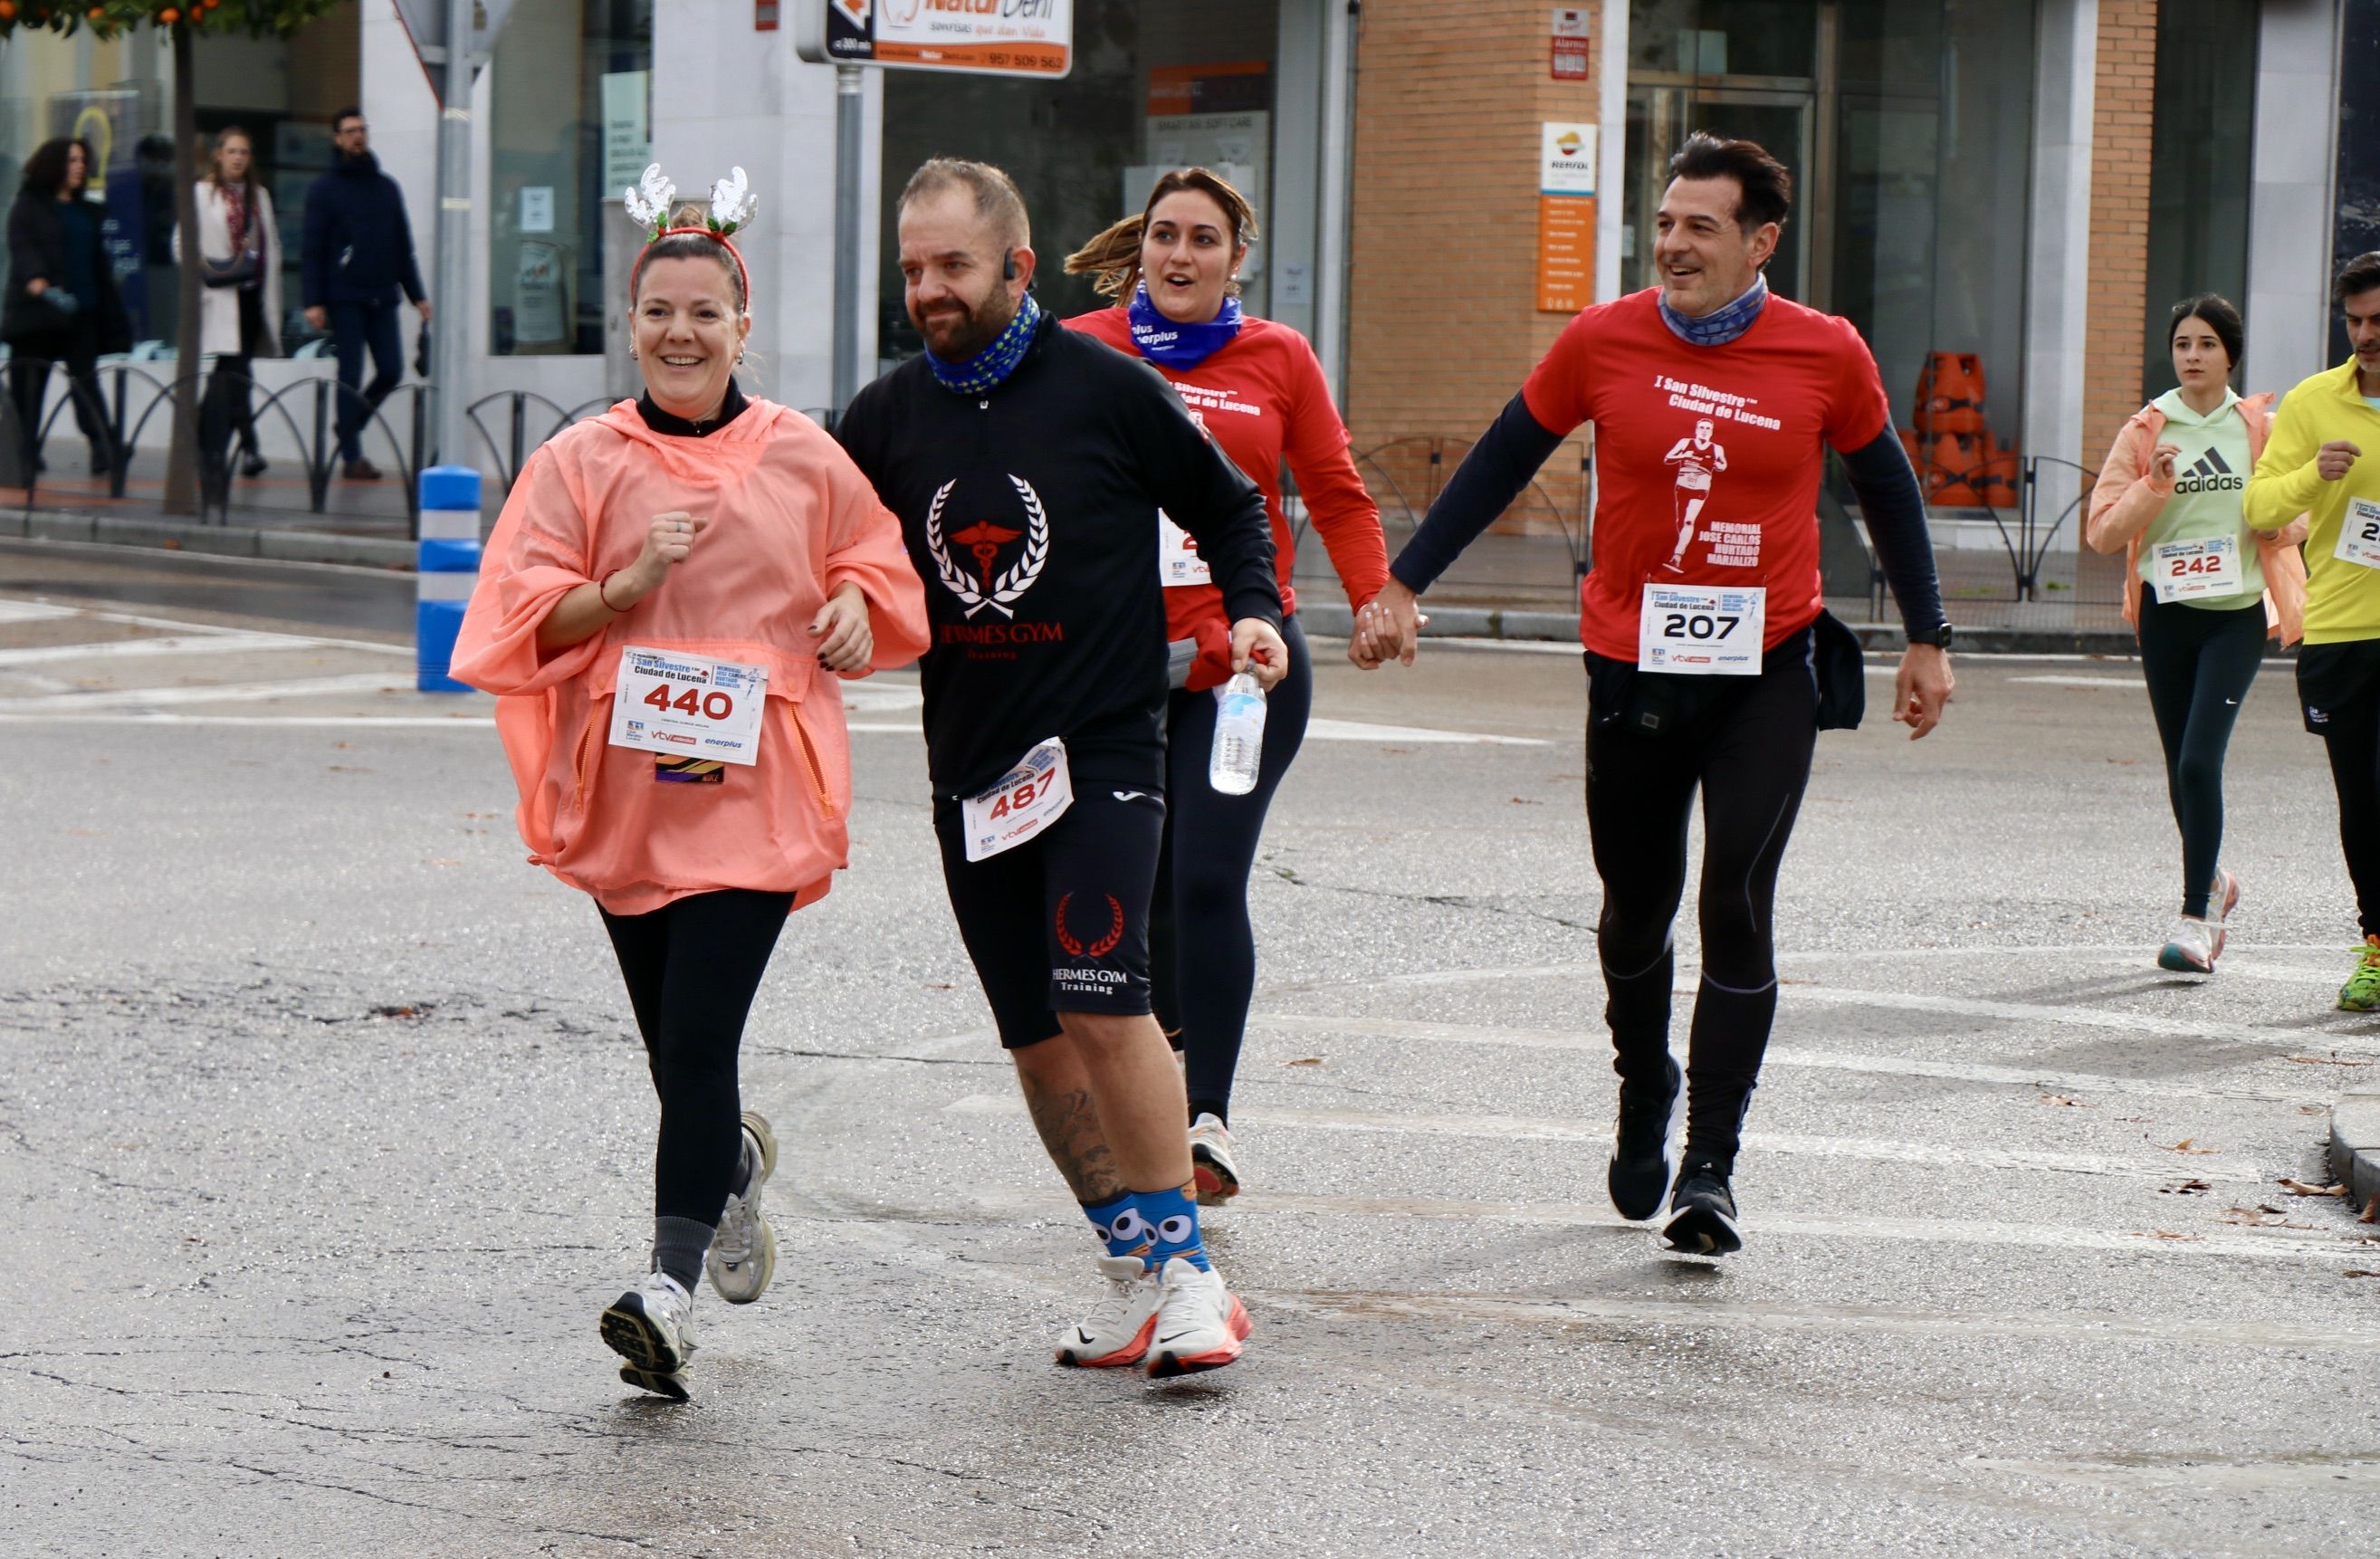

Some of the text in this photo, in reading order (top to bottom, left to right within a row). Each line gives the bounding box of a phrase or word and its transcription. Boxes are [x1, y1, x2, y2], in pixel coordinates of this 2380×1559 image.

[930, 21, 971, 33] sonrisas
[989, 53, 1064, 69] 957 509 562
[1174, 381, 1228, 398] Silvestre
[1663, 377, 1688, 395] San
[1688, 383, 1746, 407] Silvestre
[1201, 396, 1219, 408] de
[1219, 399, 1261, 416] Lucena
[1668, 393, 1782, 431] Ciudad de Lucena
[2174, 475, 2243, 495] adidas
[1710, 521, 1762, 535] MEMORIAL
[1723, 533, 1762, 546] CARLOS
[2171, 554, 2222, 577] 242
[1654, 601, 1678, 609] Ciudad
[1689, 603, 1716, 611] Lucena
[1009, 622, 1066, 644] GYM
[1663, 613, 1740, 640] 207
[636, 657, 653, 667] San
[654, 660, 691, 673] Silvestre
[635, 665, 707, 684] Ciudad de Lucena
[644, 683, 733, 721] 440
[704, 737, 742, 749] enerplus
[989, 766, 1056, 821] 487
[1052, 968, 1128, 984] HERMES GYM
[1061, 981, 1114, 996] Training
